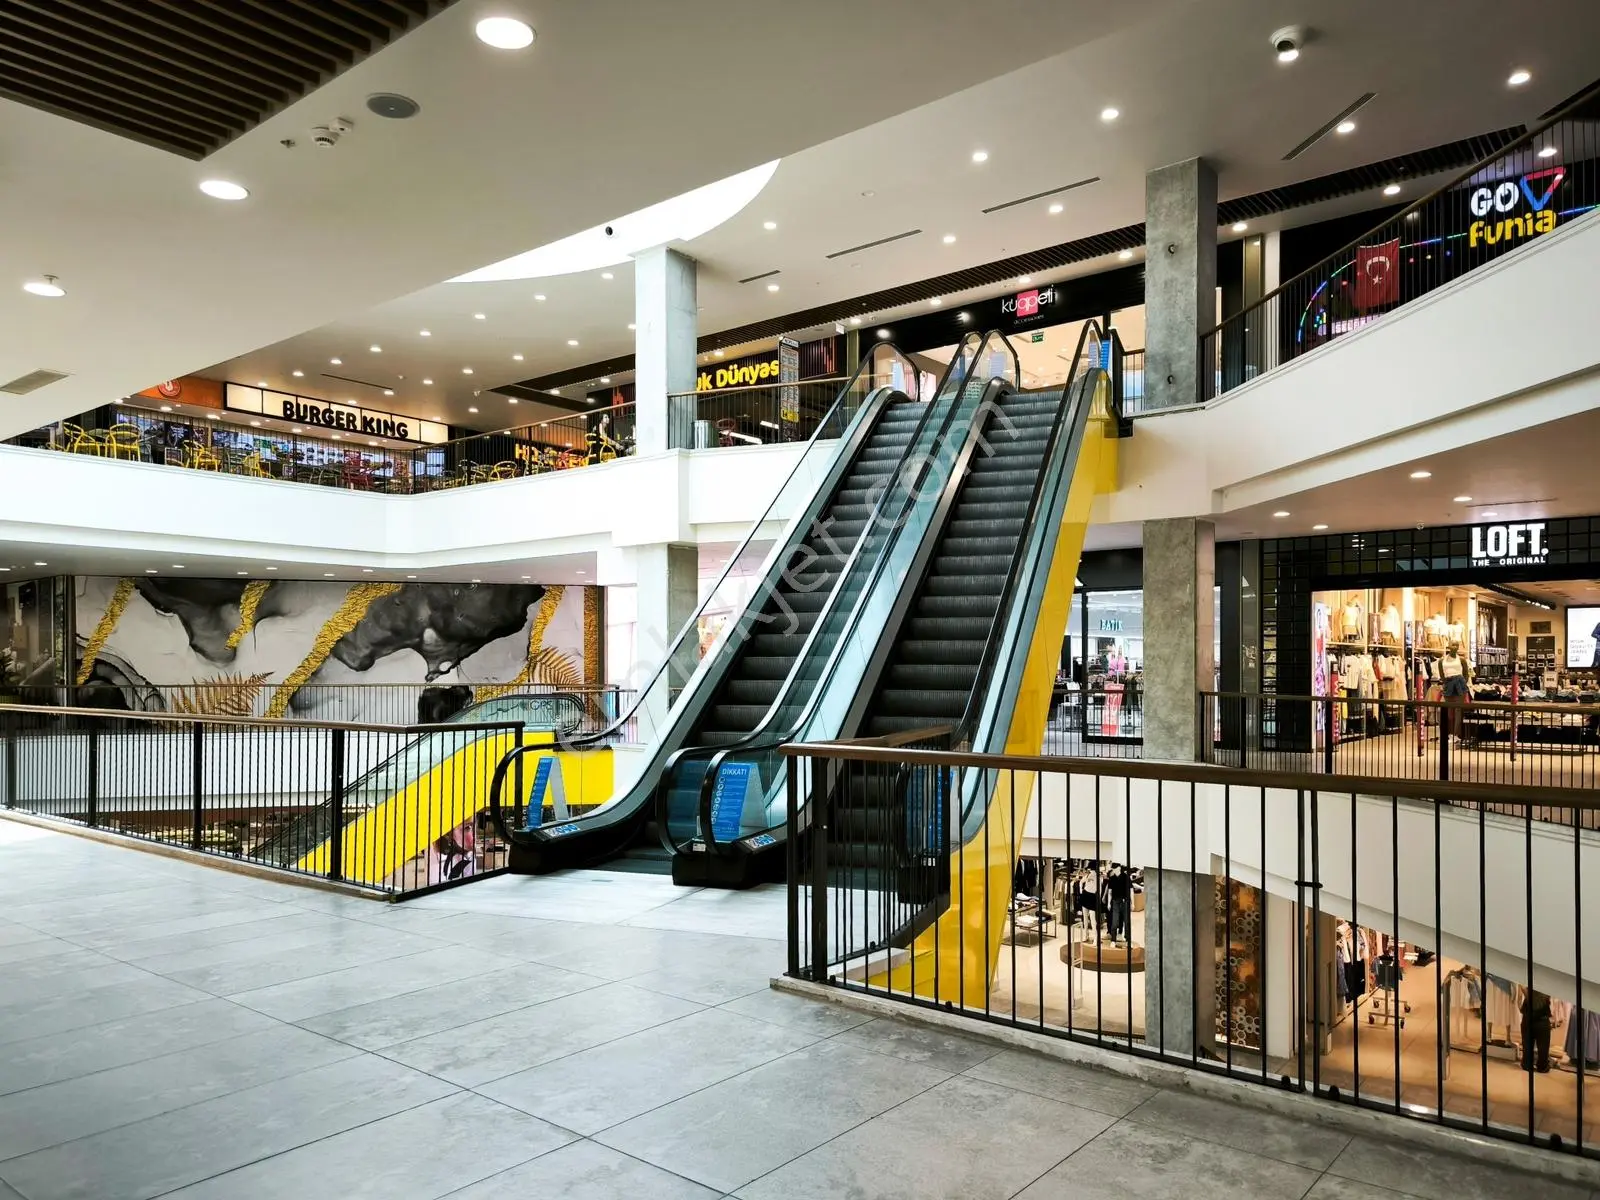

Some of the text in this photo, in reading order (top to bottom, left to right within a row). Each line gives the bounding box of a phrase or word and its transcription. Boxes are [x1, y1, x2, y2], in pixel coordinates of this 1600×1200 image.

[1471, 182, 1519, 216] GO
[1469, 210, 1556, 247] funia
[283, 400, 408, 439] BURGER KING
[1472, 556, 1546, 567] THE ORIGINAL
